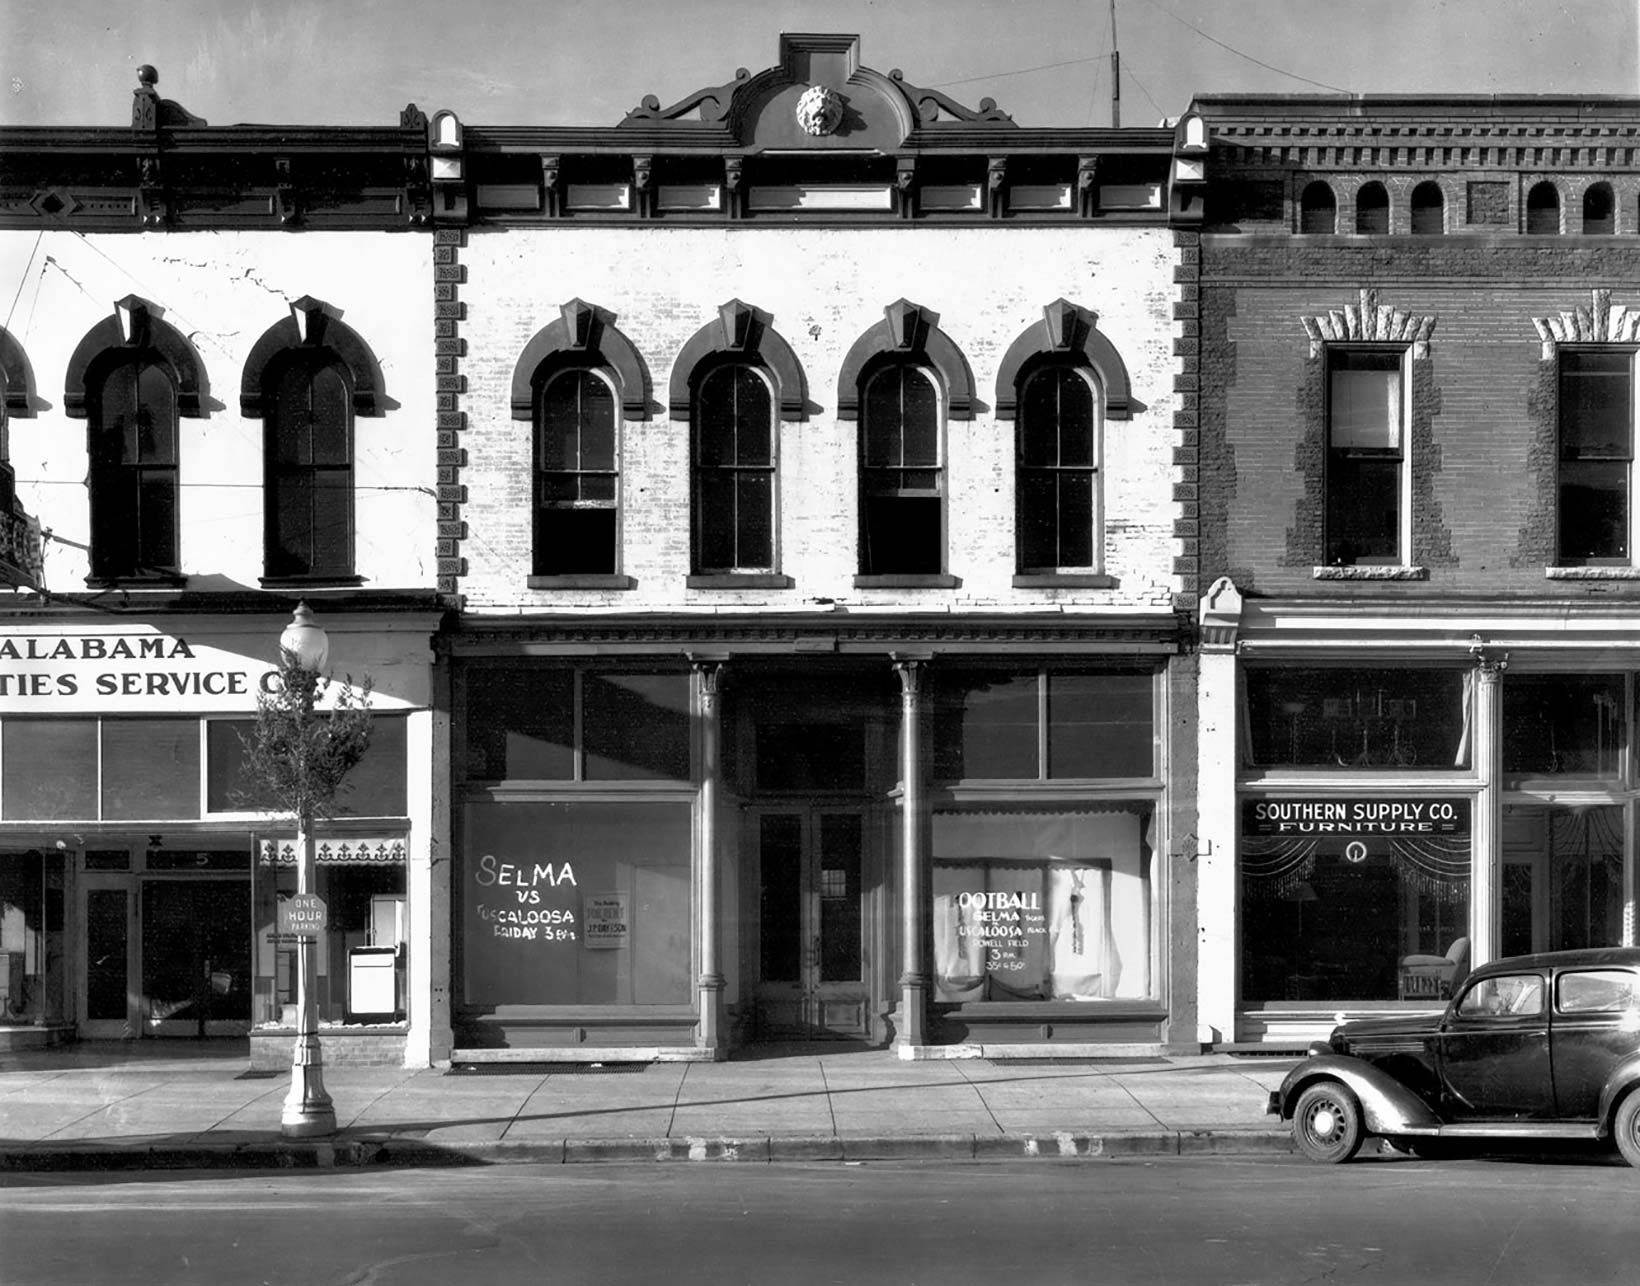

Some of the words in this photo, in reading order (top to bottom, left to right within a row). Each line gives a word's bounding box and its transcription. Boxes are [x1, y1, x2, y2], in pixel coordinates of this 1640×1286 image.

[0, 638, 196, 660] ALABAMA
[96, 671, 248, 695] SERVICE
[1255, 803, 1346, 820] SOUTHERN
[1353, 803, 1424, 820] SUPPLY
[1429, 803, 1458, 820] CO.
[1279, 822, 1433, 832] FURNITURE
[475, 855, 577, 887] SELMA
[295, 898, 317, 908] ONE
[959, 892, 1041, 910] OOTBALL
[288, 911, 322, 921] HOUR
[973, 911, 1020, 922] SELMA
[291, 922, 320, 930] PARKING
[493, 924, 538, 940] FRIDAY
[544, 926, 554, 940] 3
[1007, 939, 1029, 948] FIELD
[991, 948, 1001, 960] 3
